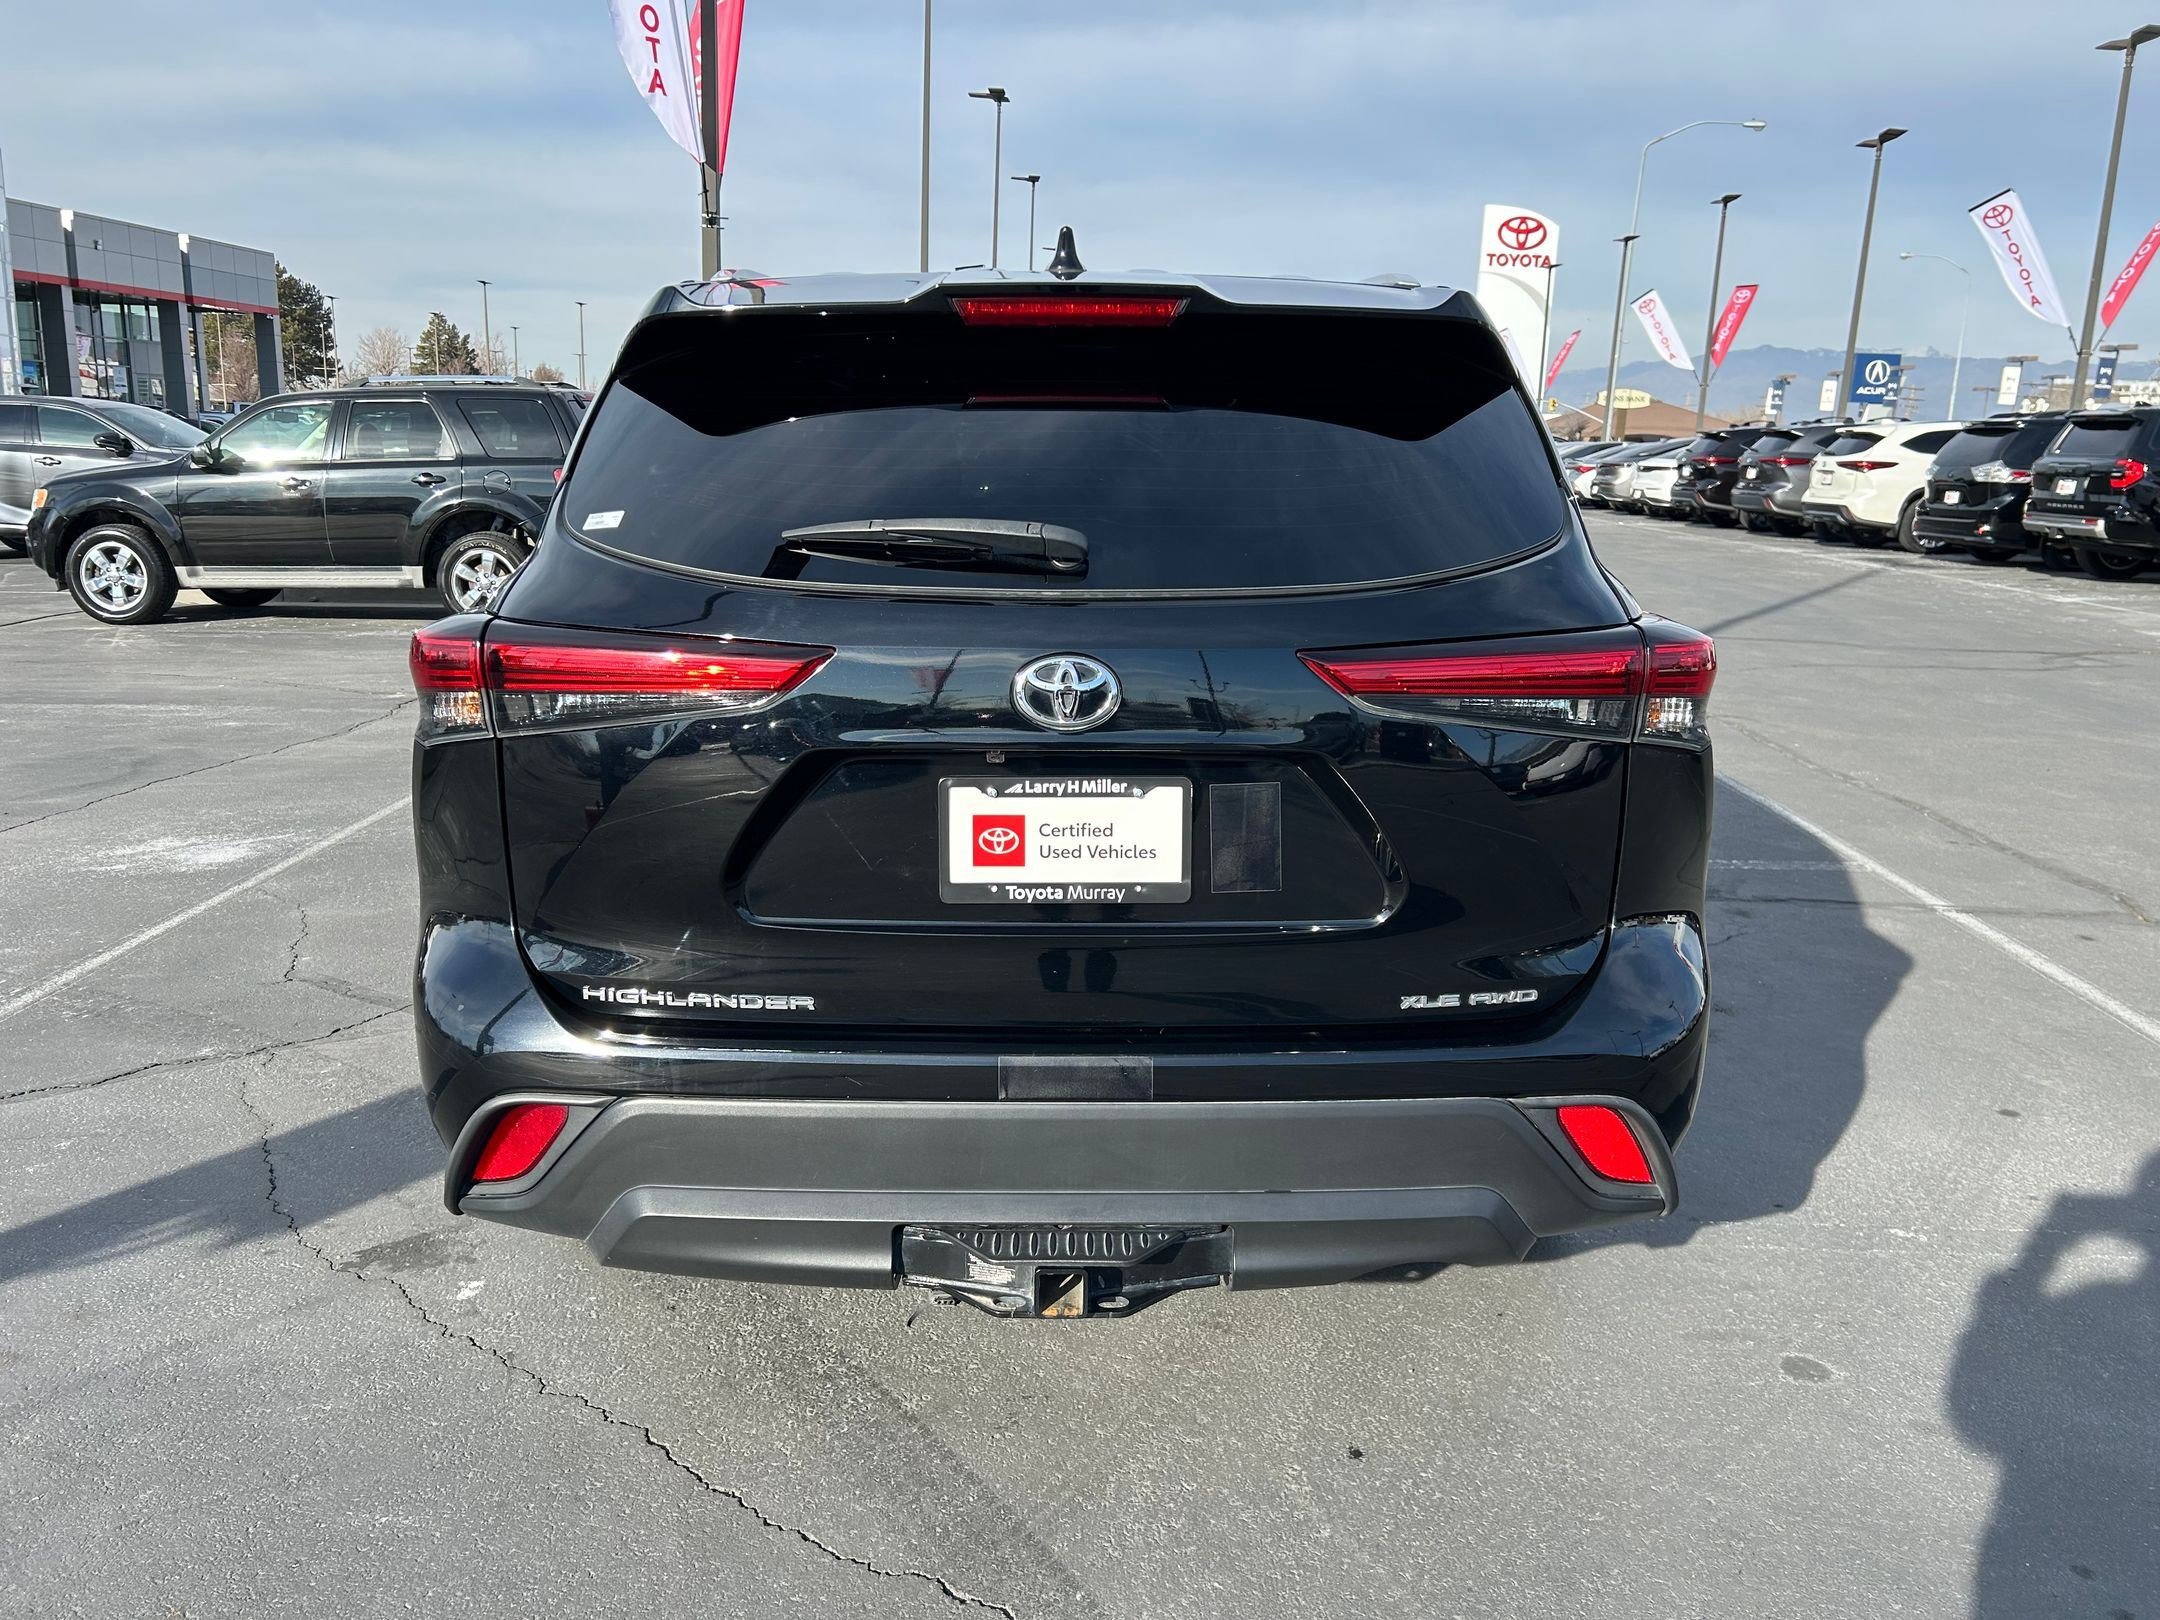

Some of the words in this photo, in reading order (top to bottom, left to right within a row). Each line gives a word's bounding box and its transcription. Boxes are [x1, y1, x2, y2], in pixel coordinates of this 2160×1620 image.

[1486, 253, 1552, 268] TOYOTA
[2001, 230, 2042, 308] TOYOTA
[2103, 231, 2160, 303] TOYOTA
[1650, 314, 1677, 360] TOYOTA
[1712, 304, 1741, 351] TOYOTA
[1856, 386, 1887, 396] ACUR
[1024, 780, 1065, 797] Larry
[1067, 780, 1079, 794] H
[1081, 780, 1128, 794] Miller
[1039, 822, 1114, 838] Certified
[1039, 844, 1083, 860] Used
[1087, 844, 1157, 860] Vehicles
[1005, 885, 1064, 903] Toyota
[1067, 885, 1126, 903] Murray
[582, 985, 816, 1011] HIGHLANDER
[1400, 994, 1461, 1010] XLE
[1468, 989, 1539, 1006] AWD
